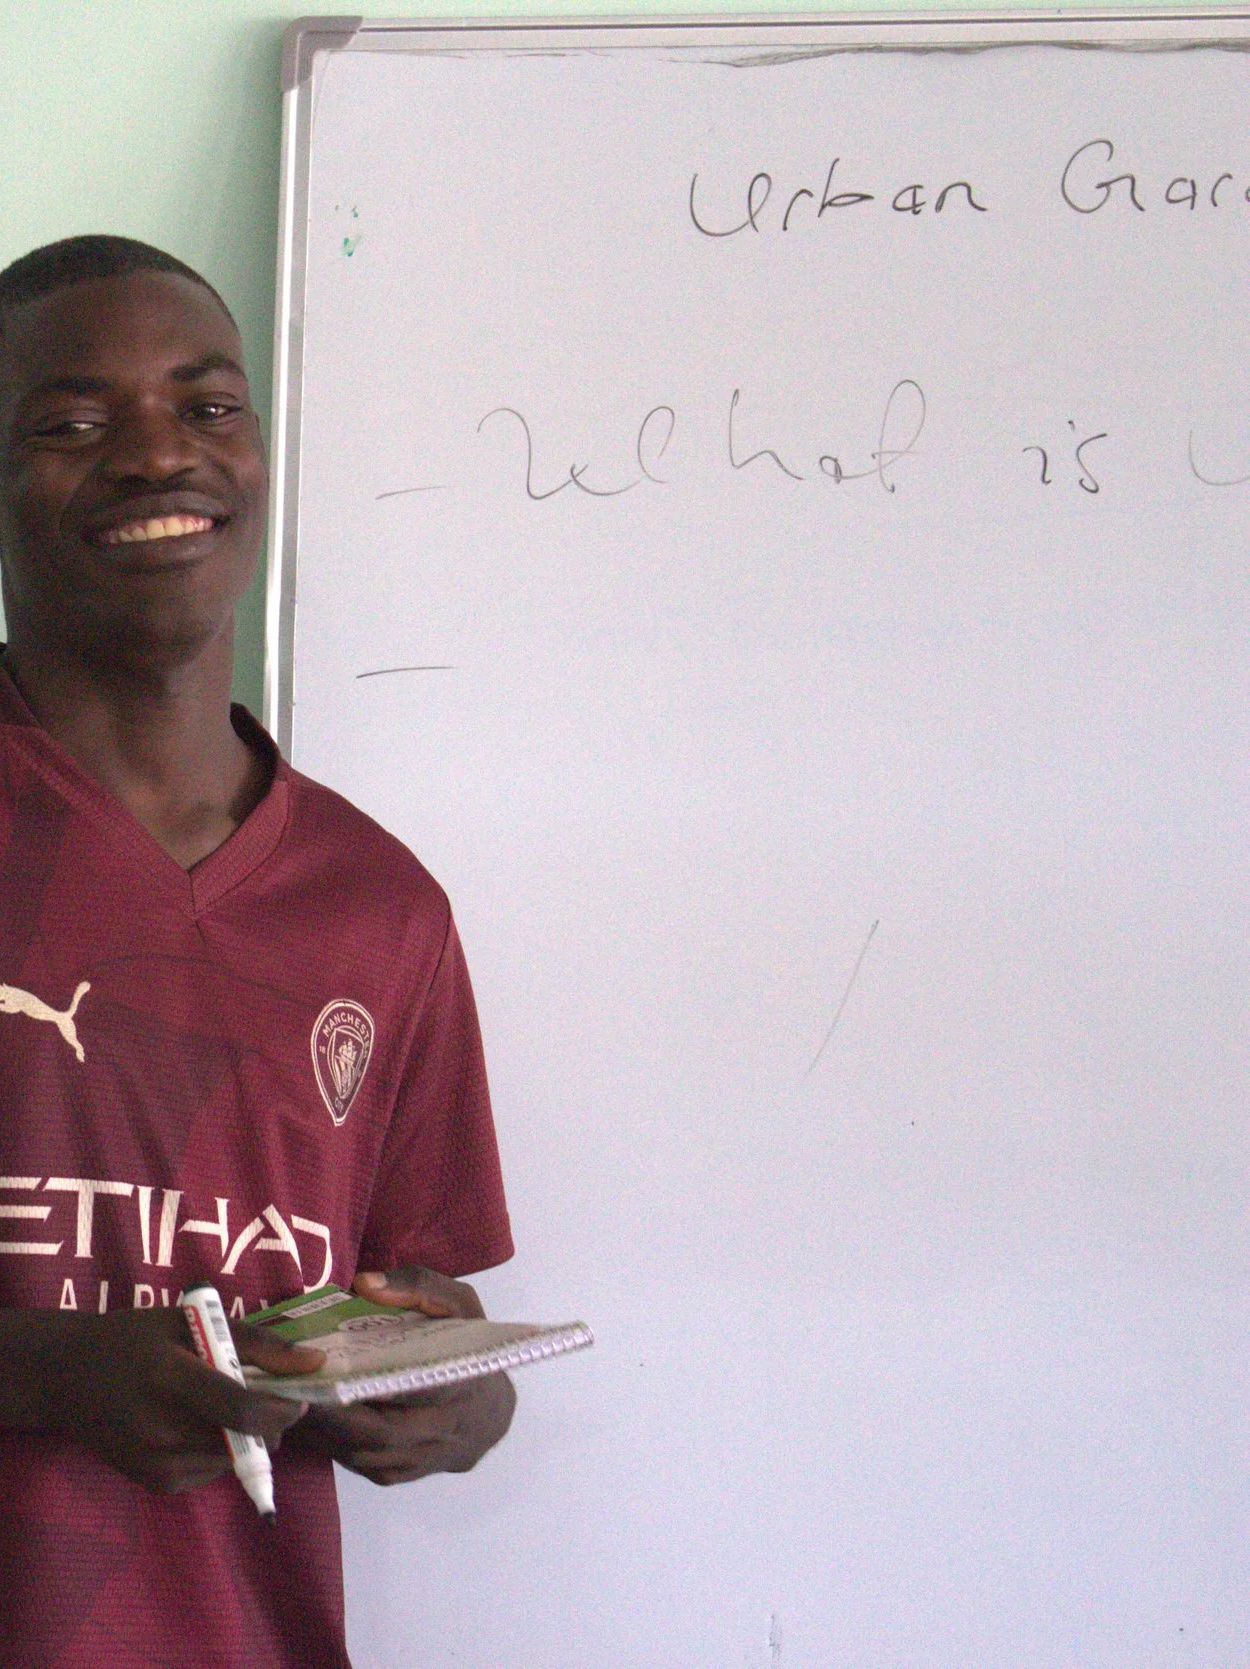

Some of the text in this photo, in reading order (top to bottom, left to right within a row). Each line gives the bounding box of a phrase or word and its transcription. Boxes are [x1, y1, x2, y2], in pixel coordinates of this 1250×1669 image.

[689, 138, 1250, 238] Urban Gar
[1022, 419, 1108, 494] is
[322, 1011, 370, 1059] MANCHEST
